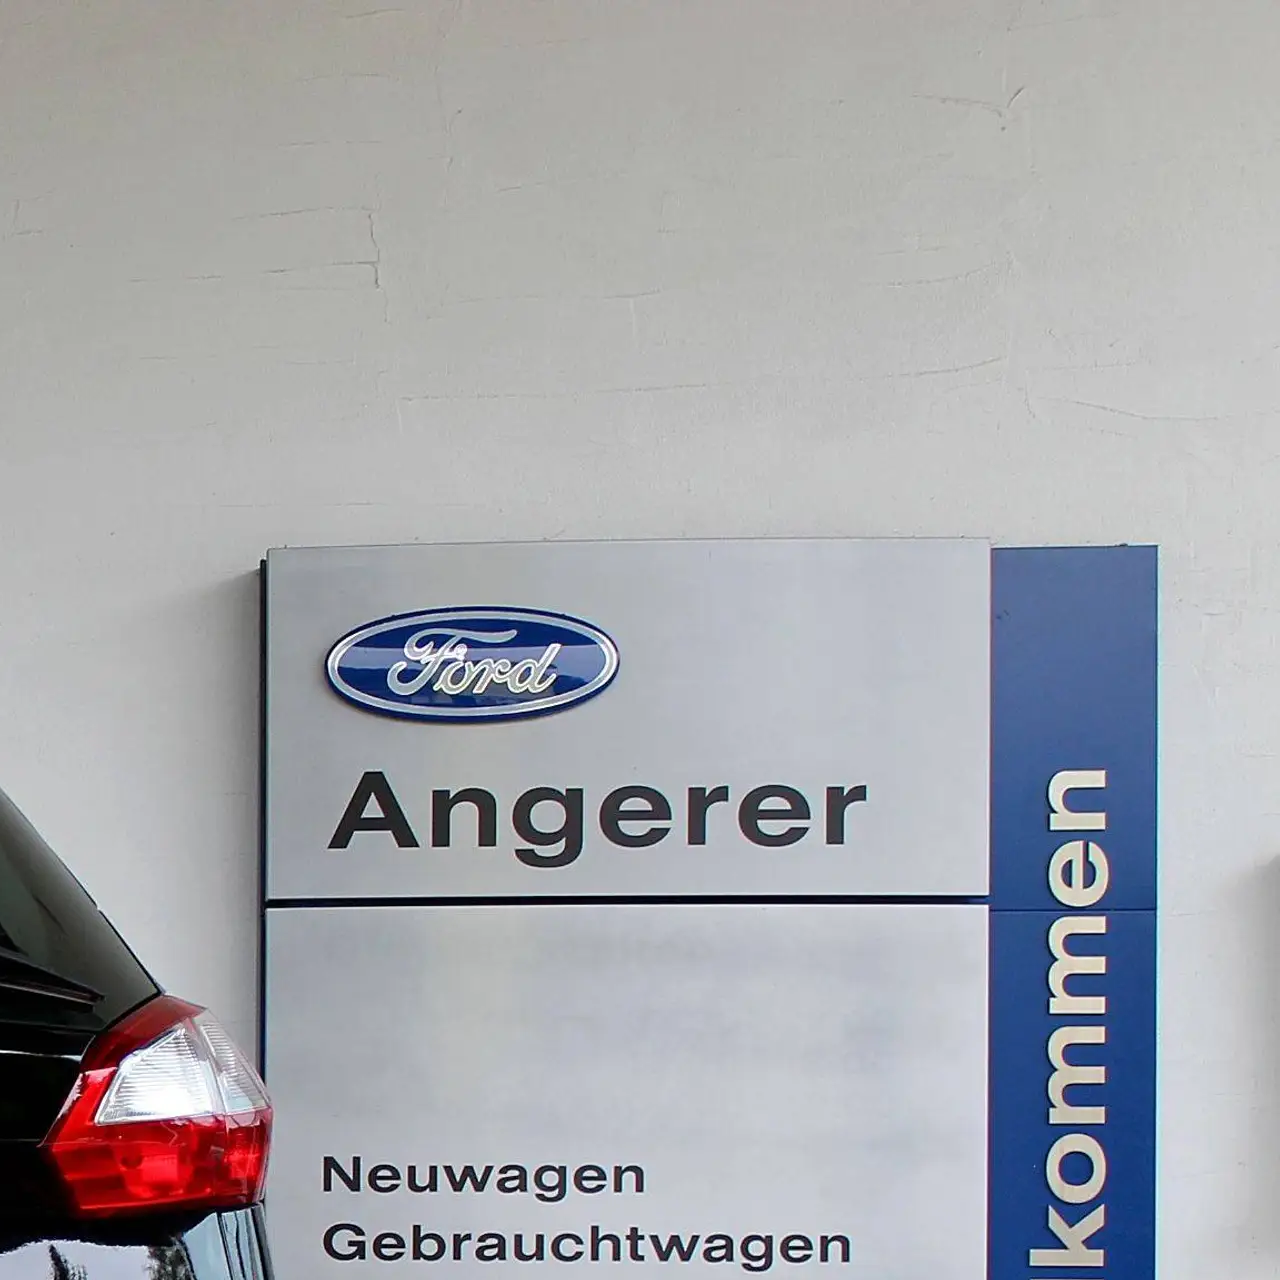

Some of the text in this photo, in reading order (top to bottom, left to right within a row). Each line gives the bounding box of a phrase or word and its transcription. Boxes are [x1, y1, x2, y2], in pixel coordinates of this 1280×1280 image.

[386, 626, 564, 696] Ford
[326, 770, 867, 869] Angerer
[322, 1155, 645, 1202] Neuwagen
[322, 1223, 851, 1273] Gebrauchtwagen
